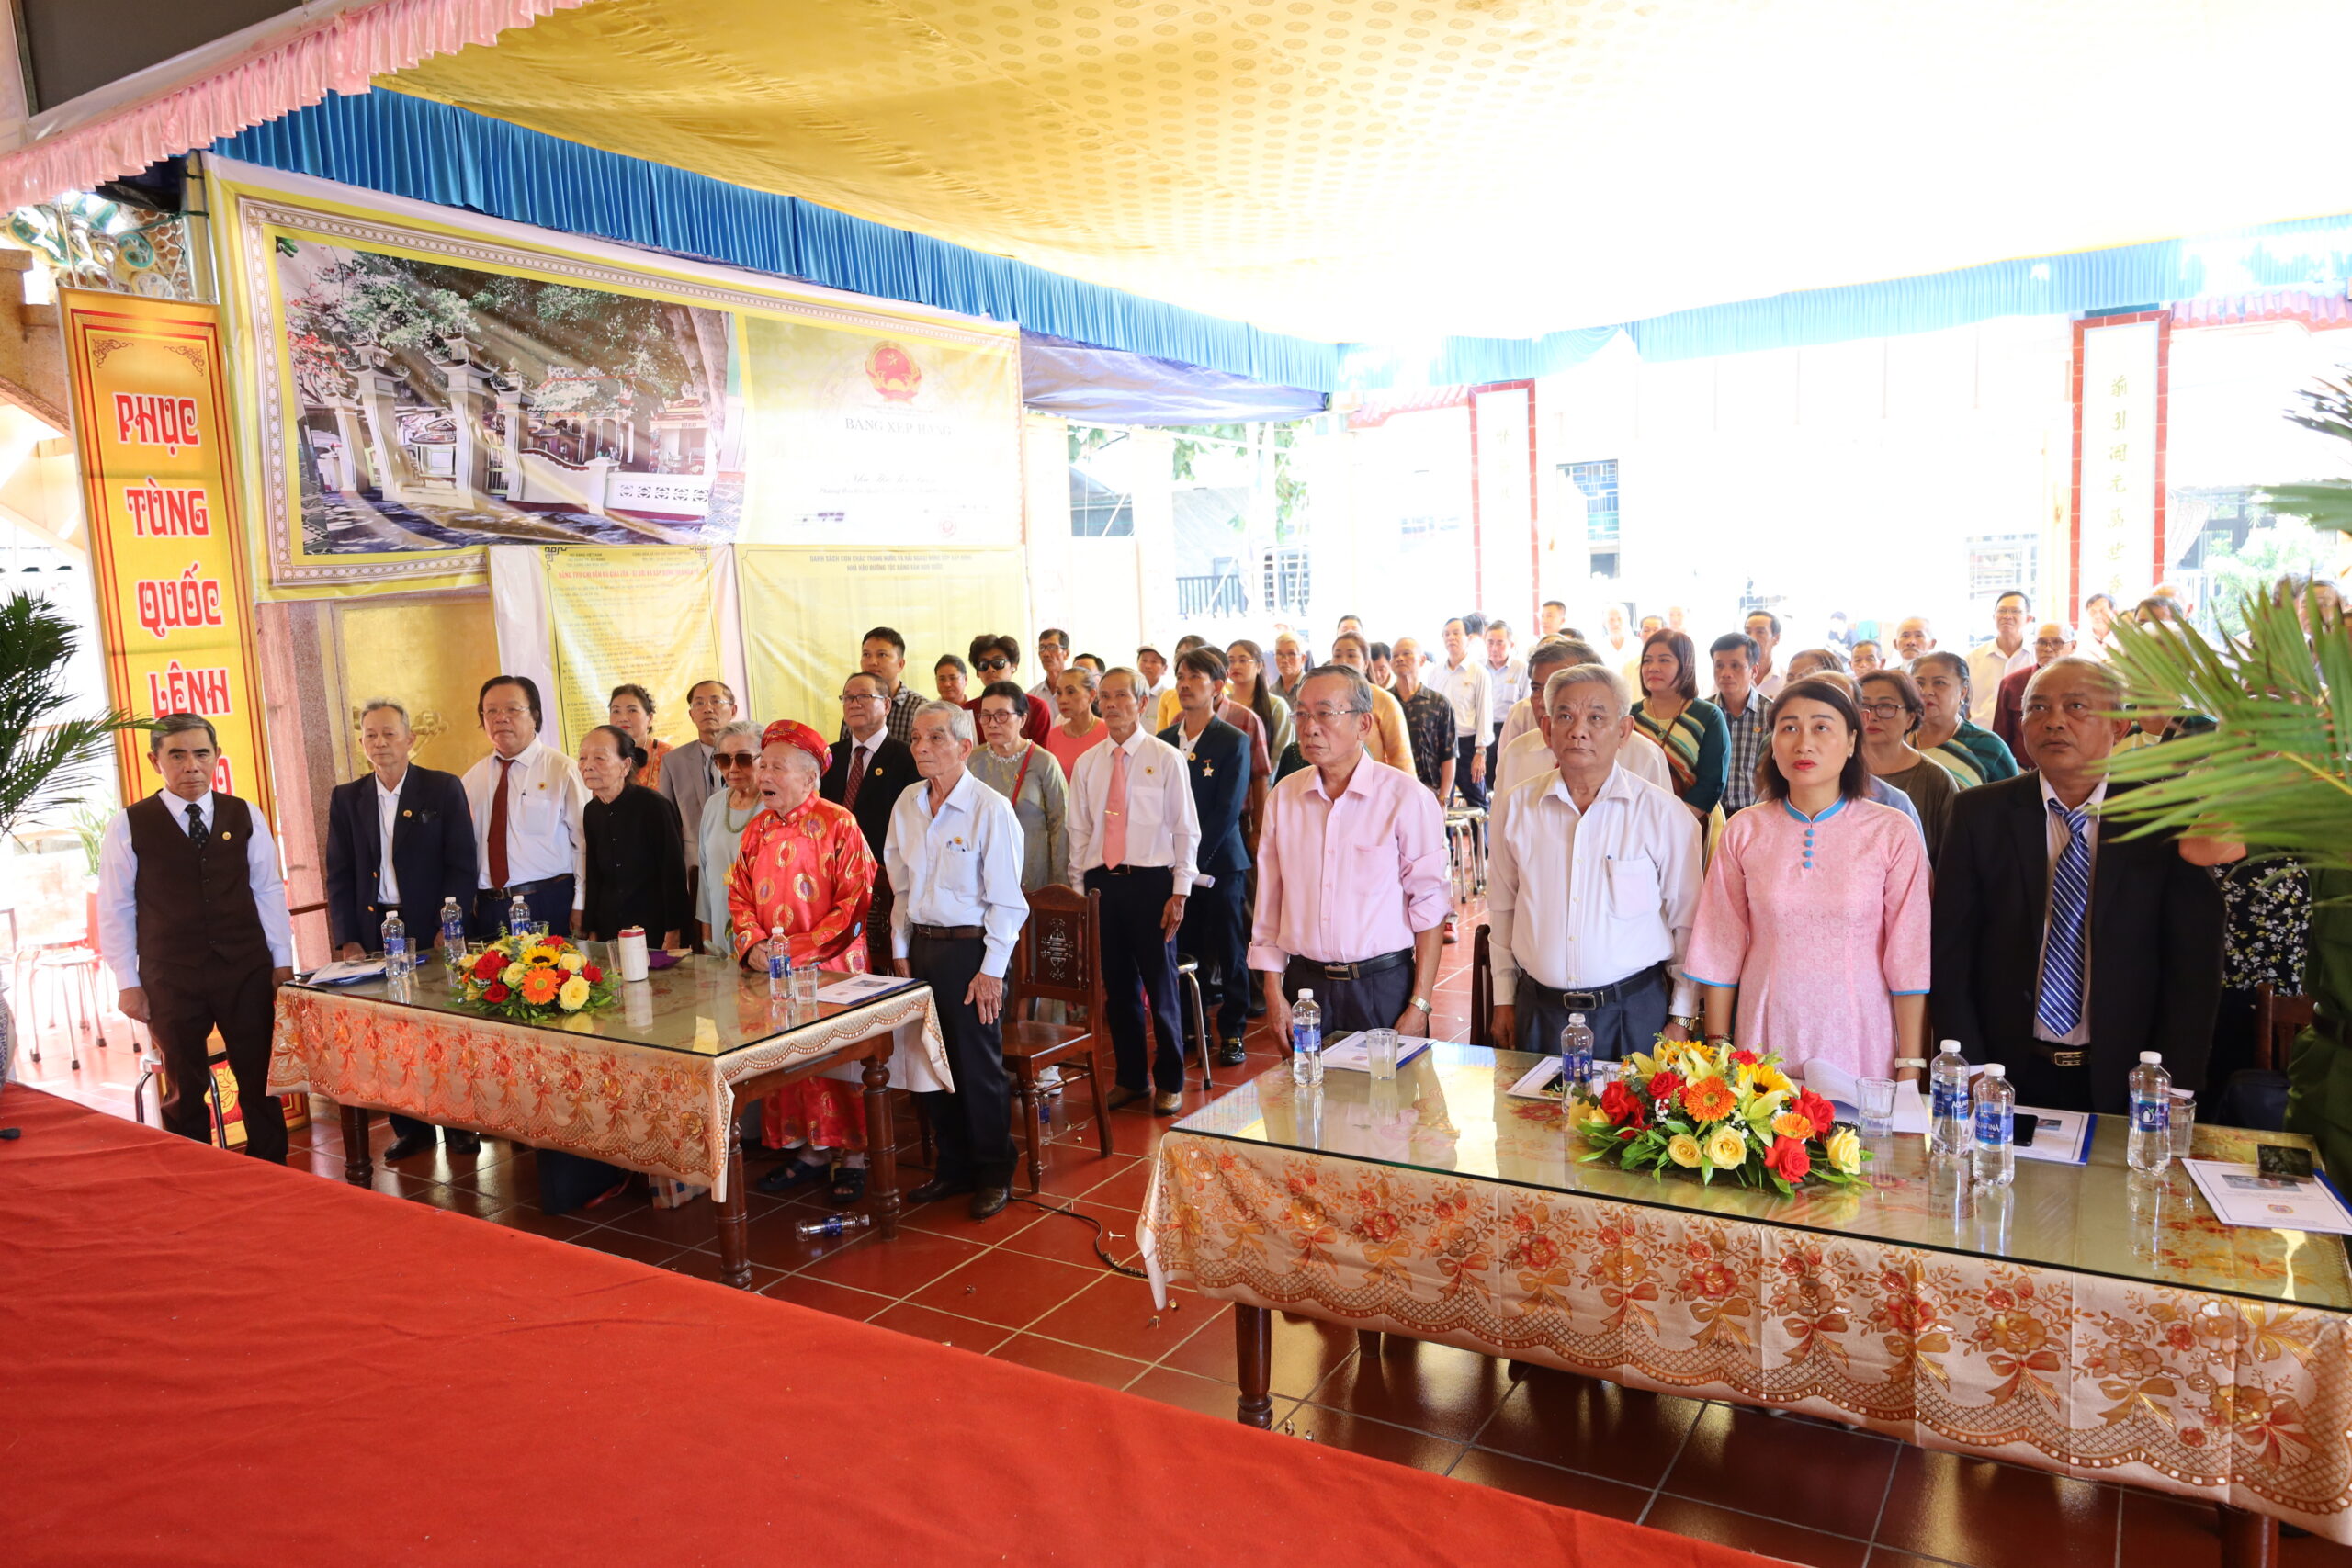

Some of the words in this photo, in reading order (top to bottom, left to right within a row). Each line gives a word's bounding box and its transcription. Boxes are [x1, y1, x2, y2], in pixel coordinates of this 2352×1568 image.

[115, 394, 199, 456] PHỤC
[126, 478, 209, 536] TÙNG
[137, 563, 222, 637] QUỐC
